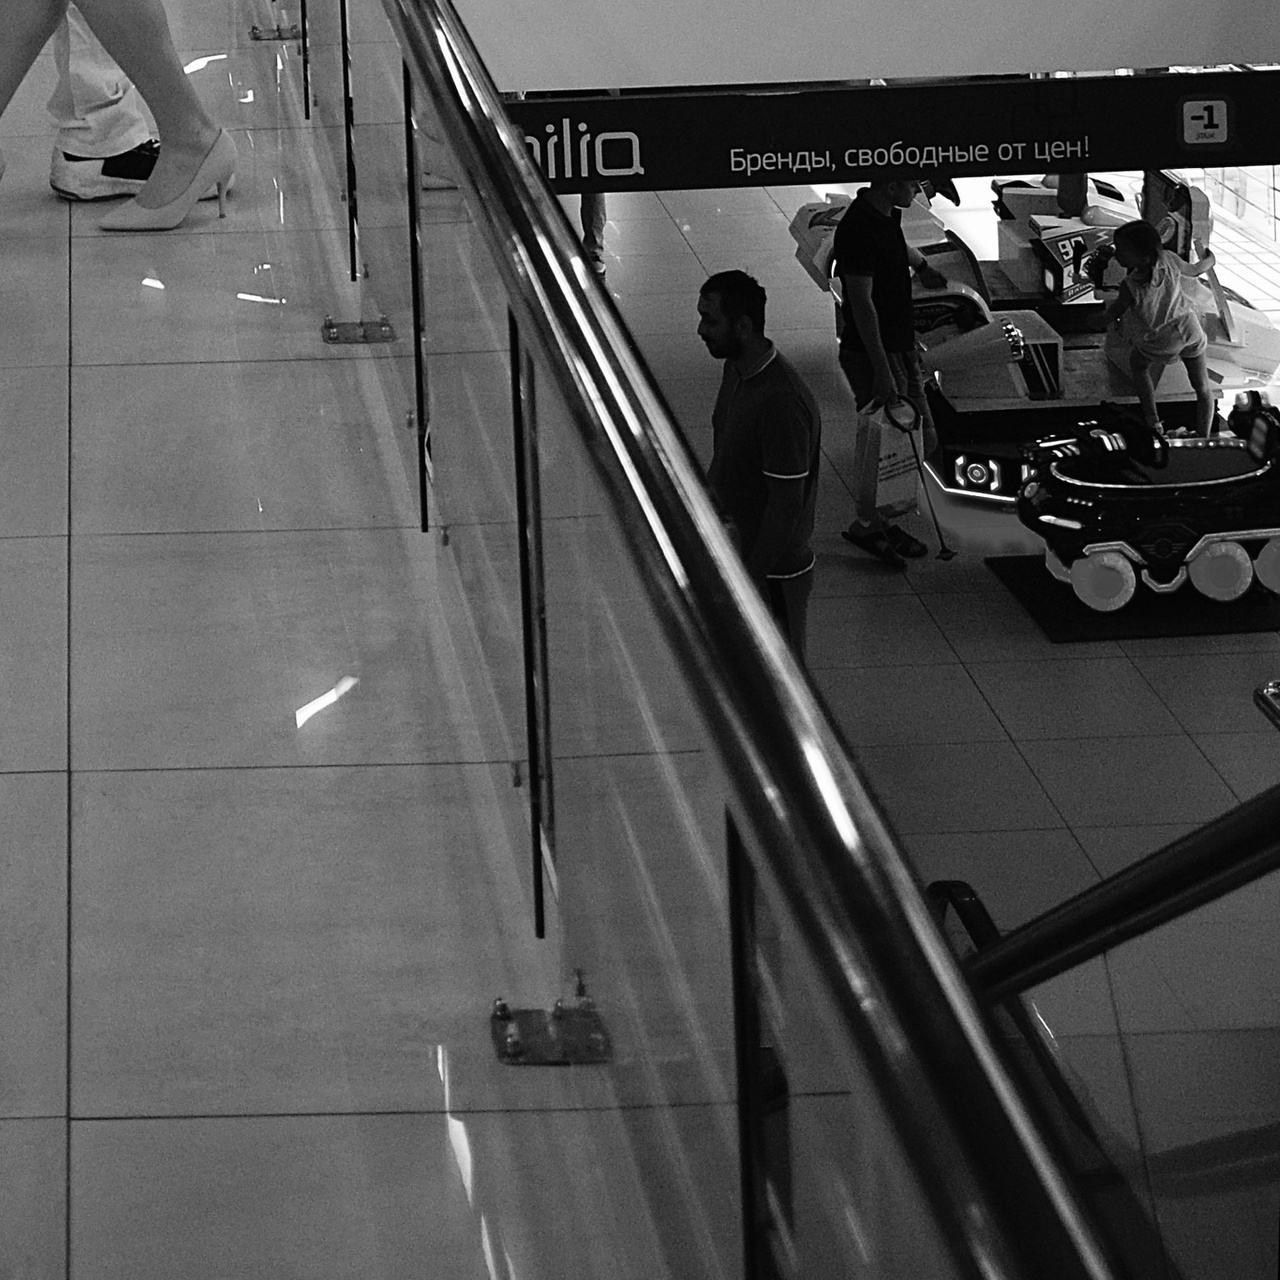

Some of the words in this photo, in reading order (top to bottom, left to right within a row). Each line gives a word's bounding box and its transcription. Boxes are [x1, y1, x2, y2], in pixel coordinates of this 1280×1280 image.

[730, 147, 837, 176] Бренды,
[844, 141, 989, 168] свободные
[998, 143, 1026, 161] от
[1034, 136, 1090, 162] цен!
